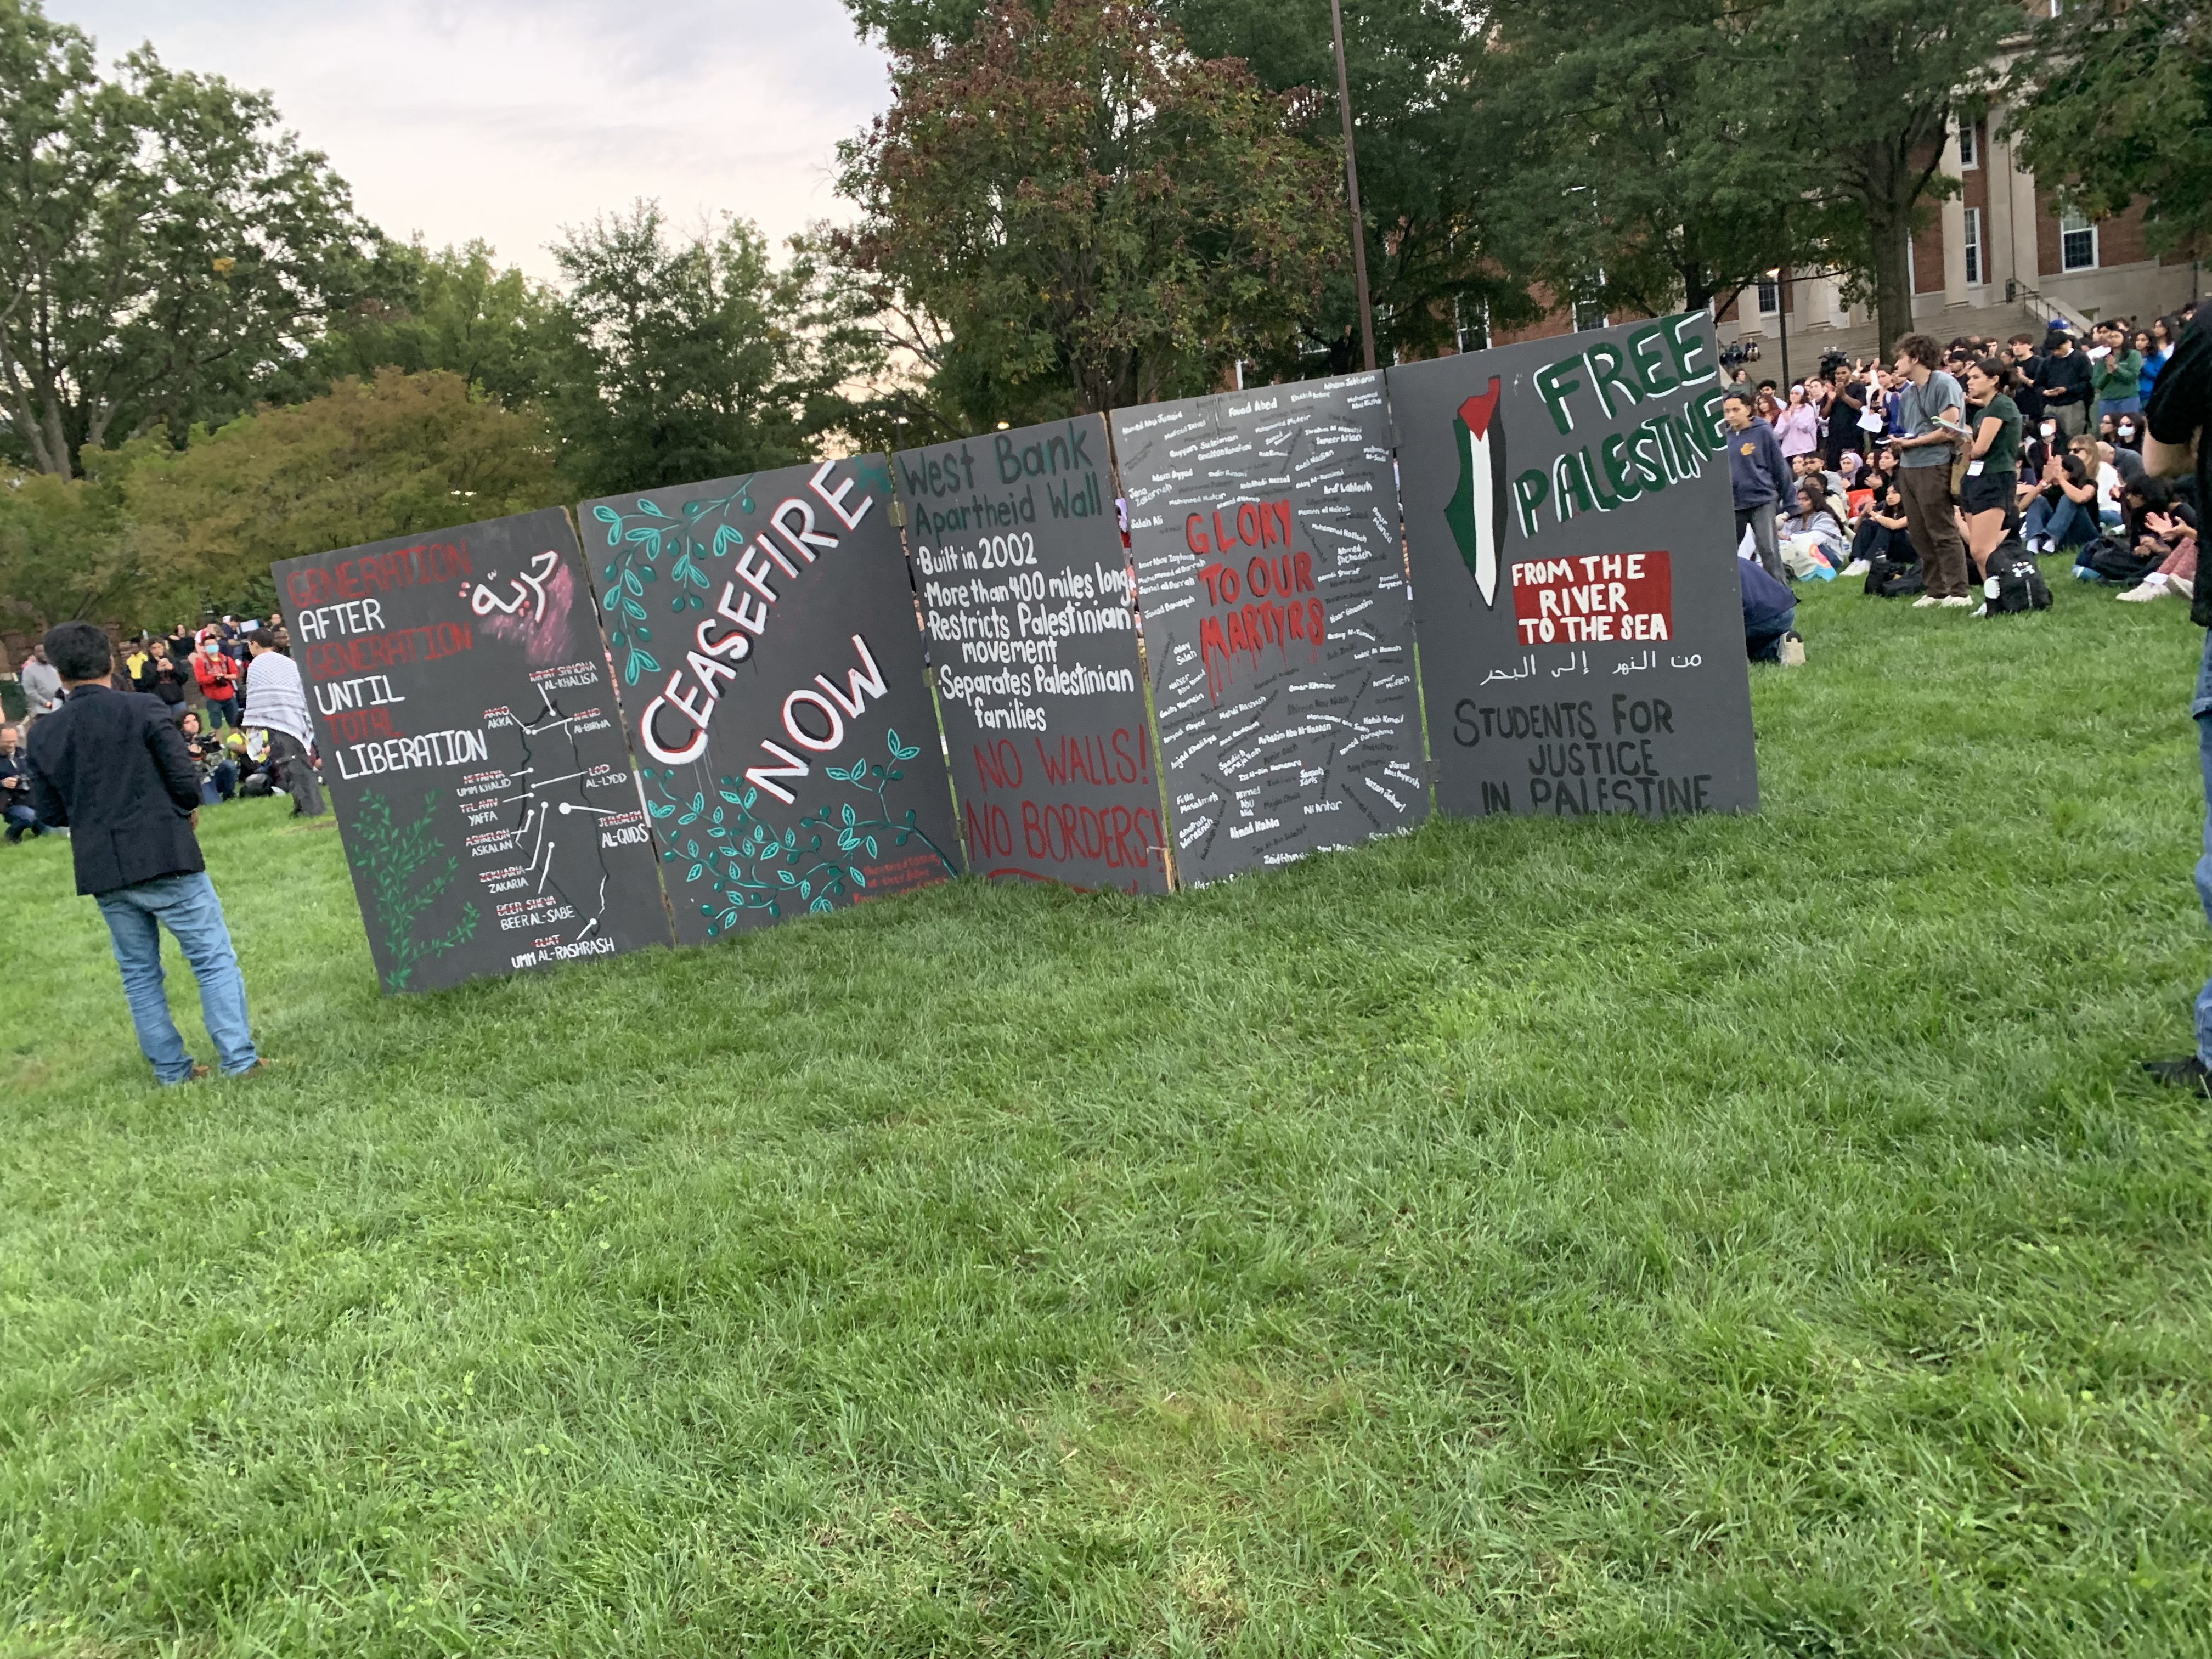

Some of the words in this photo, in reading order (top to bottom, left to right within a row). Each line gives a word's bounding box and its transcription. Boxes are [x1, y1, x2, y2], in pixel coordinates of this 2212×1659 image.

[1533, 310, 1717, 436] FREE
[1254, 397, 1278, 411] Abed
[898, 443, 974, 498] West
[994, 420, 1093, 484] Bank
[1513, 385, 1729, 539] PALESTINE
[916, 484, 1035, 548] Apartheid
[1046, 471, 1102, 518] Wall
[1153, 515, 1164, 527] Ali
[1186, 498, 1293, 554] GLORY
[961, 545, 978, 571] in
[979, 532, 1037, 569] 2002
[1512, 558, 1574, 588] FROM
[1580, 553, 1646, 582] THE
[287, 539, 472, 608] GENERATION
[972, 579, 1008, 603] than
[1009, 571, 1045, 603] 400
[1048, 566, 1093, 600] miles
[1095, 561, 1131, 606] long
[1199, 563, 1240, 606] TO
[1248, 551, 1316, 598] OUR
[639, 458, 873, 765] CEASEFIRE
[1539, 582, 1629, 614] RIVER
[298, 598, 385, 642] AFTER
[928, 609, 1011, 641] Restricts
[1017, 600, 1132, 638] Palestinian
[1200, 596, 1324, 662] MARTYRS
[1519, 616, 1556, 645] TO
[1560, 615, 1615, 642] THE
[1621, 612, 1668, 641] SEA
[306, 622, 472, 681] GENERATION
[962, 636, 1058, 664] movement
[1612, 650, 1656, 675] النهر
[1671, 653, 1702, 669] من
[545, 673, 598, 690] AL-KHALISA
[940, 664, 1032, 707] Separates
[1033, 662, 1134, 697] Palestinian
[1480, 653, 1536, 686] البحر
[314, 674, 405, 715] UNTIL
[324, 708, 403, 744] TOTAL
[488, 716, 513, 729] AKKA
[743, 634, 888, 805] NOW
[974, 698, 1047, 731] families
[1453, 698, 1596, 748] STUDENTS
[1613, 693, 1674, 735] FOR
[335, 728, 488, 780] LIBERATION
[588, 764, 610, 776] LOD
[973, 738, 1023, 794] NO
[1035, 723, 1150, 787] WALLS!
[1528, 739, 1660, 777] JUSTICE
[456, 786, 478, 797] UMM
[480, 778, 511, 792] KHALID
[585, 772, 627, 788] AL-LYDD
[1480, 781, 1511, 813] IN
[1533, 774, 1713, 816] PALESTINE
[468, 811, 498, 827] YAFFA
[602, 823, 649, 848] AL-QUDS
[966, 799, 1013, 861] NO
[1022, 800, 1164, 873] BORDERS!
[472, 840, 513, 857] ASKALAN
[488, 877, 529, 894] ZAKARIA
[500, 915, 529, 930] BEER
[531, 906, 575, 924] AL-SABE
[511, 952, 537, 968] UMM
[538, 936, 615, 962] AL-RASHRASH
